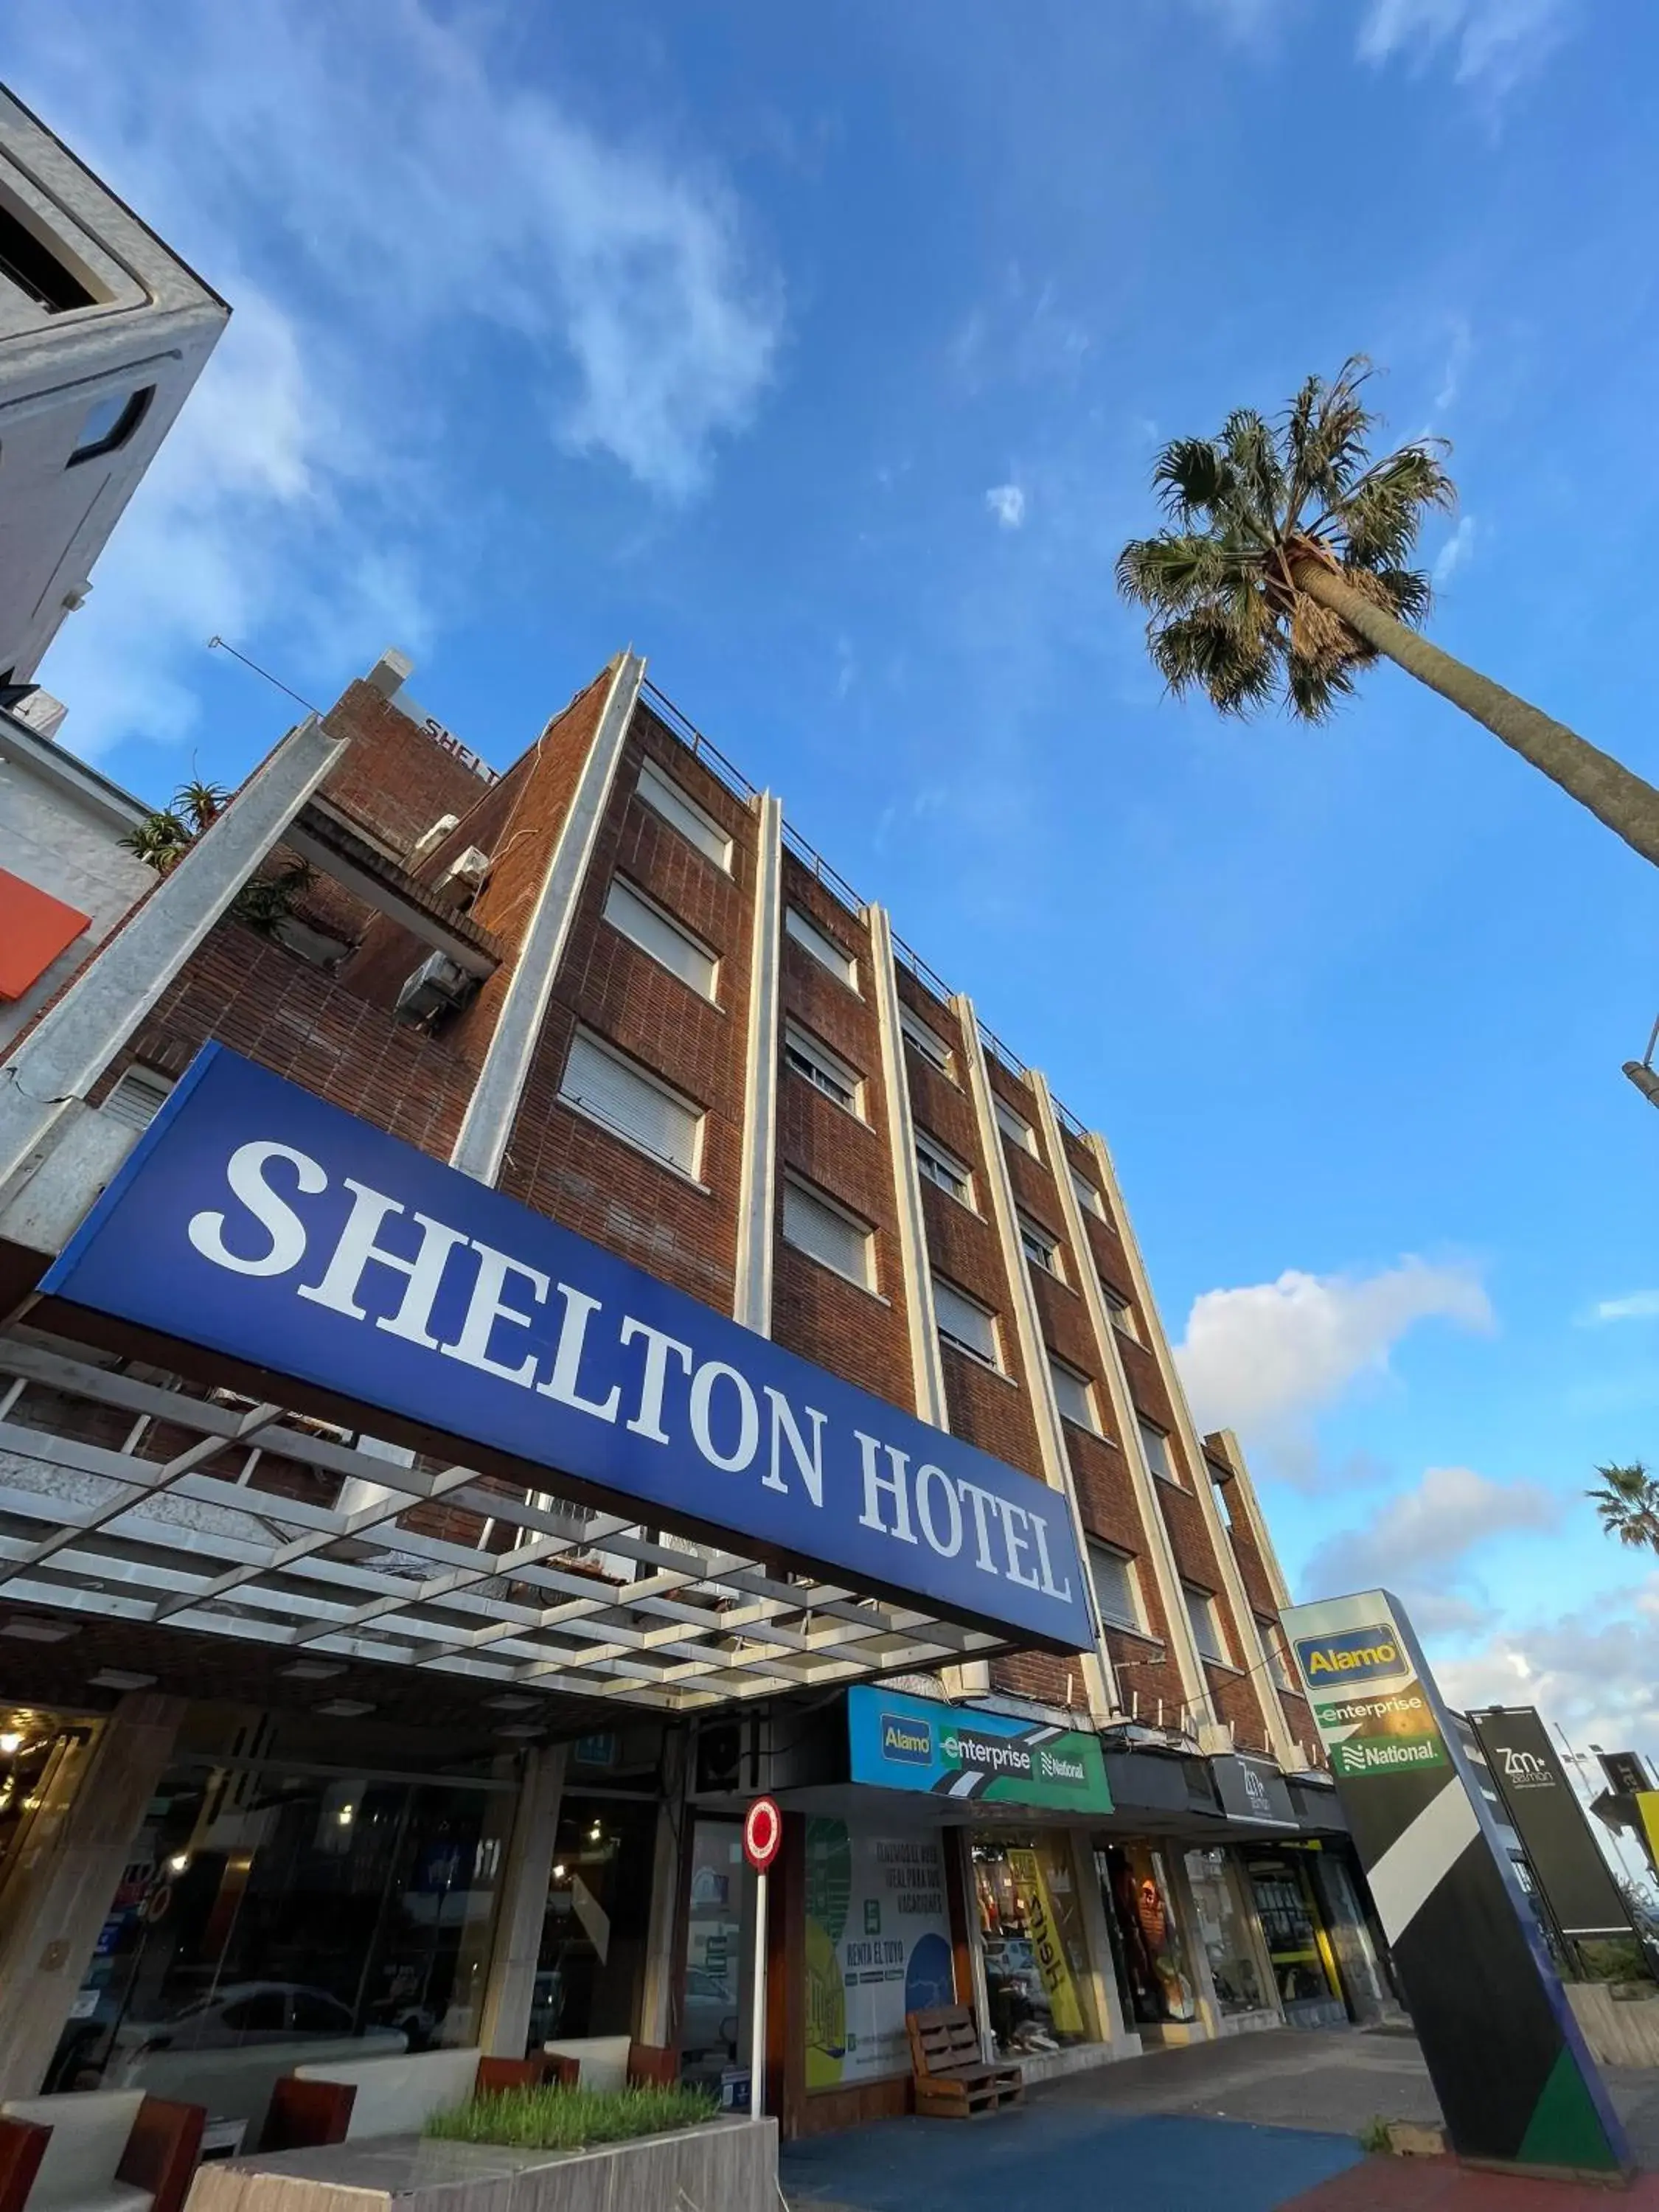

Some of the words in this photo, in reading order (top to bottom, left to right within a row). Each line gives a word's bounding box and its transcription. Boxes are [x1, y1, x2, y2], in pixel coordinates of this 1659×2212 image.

[189, 1141, 827, 1508] SHELTON
[854, 1430, 1072, 1604] HOTEL
[1310, 1645, 1395, 1674] Alamo
[1318, 1697, 1422, 1722] enterprise
[886, 1727, 929, 1753] Alamo
[940, 1736, 1031, 1770] enterprise
